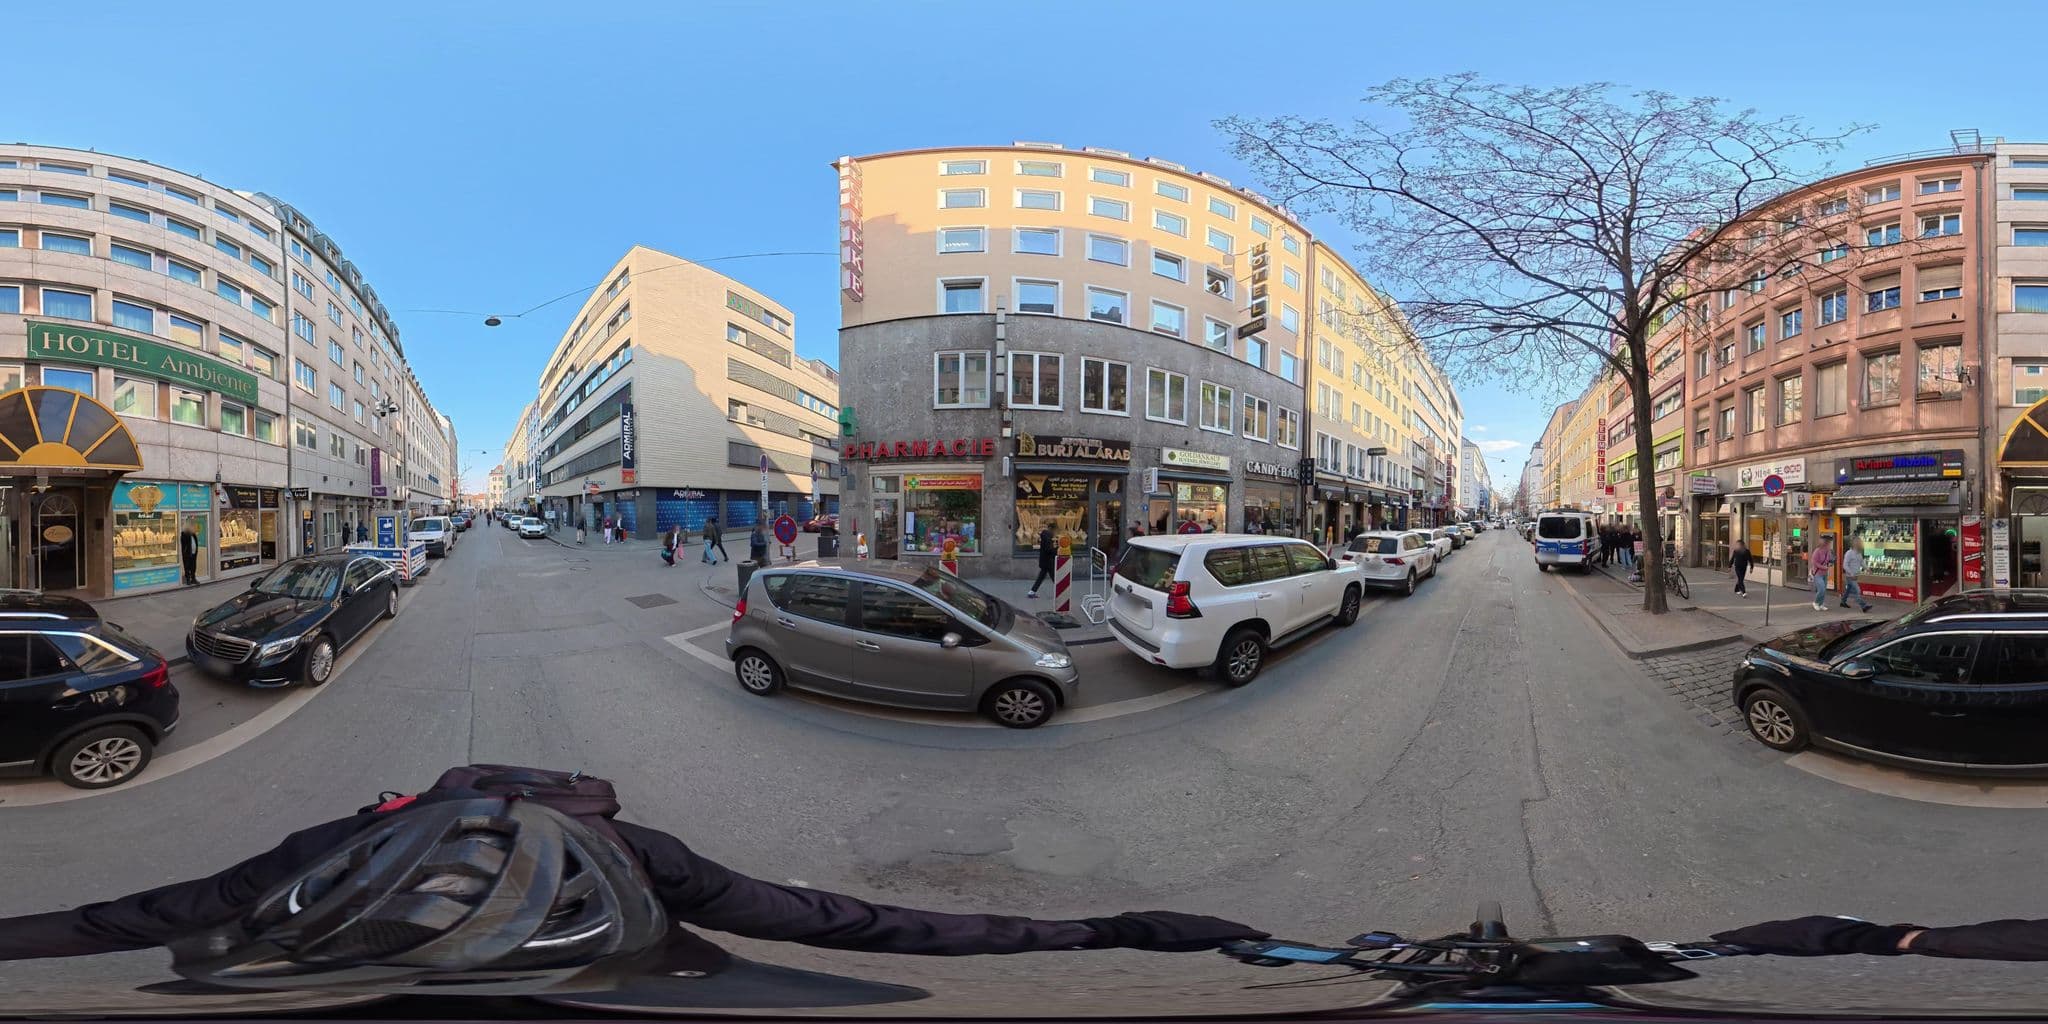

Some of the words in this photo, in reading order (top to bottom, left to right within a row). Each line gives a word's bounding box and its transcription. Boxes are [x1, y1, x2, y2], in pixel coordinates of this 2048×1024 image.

[1252, 243, 1265, 313] HOTEL
[42, 331, 148, 366] HOTEL
[160, 354, 252, 394] Ambiente
[623, 412, 631, 460] ADMIRAL
[845, 438, 994, 460] PHARMACIE
[1038, 444, 1073, 458] BURJ
[1074, 446, 1094, 458] AL
[1095, 447, 1132, 461] ARAB
[1247, 461, 1280, 476] CANDY
